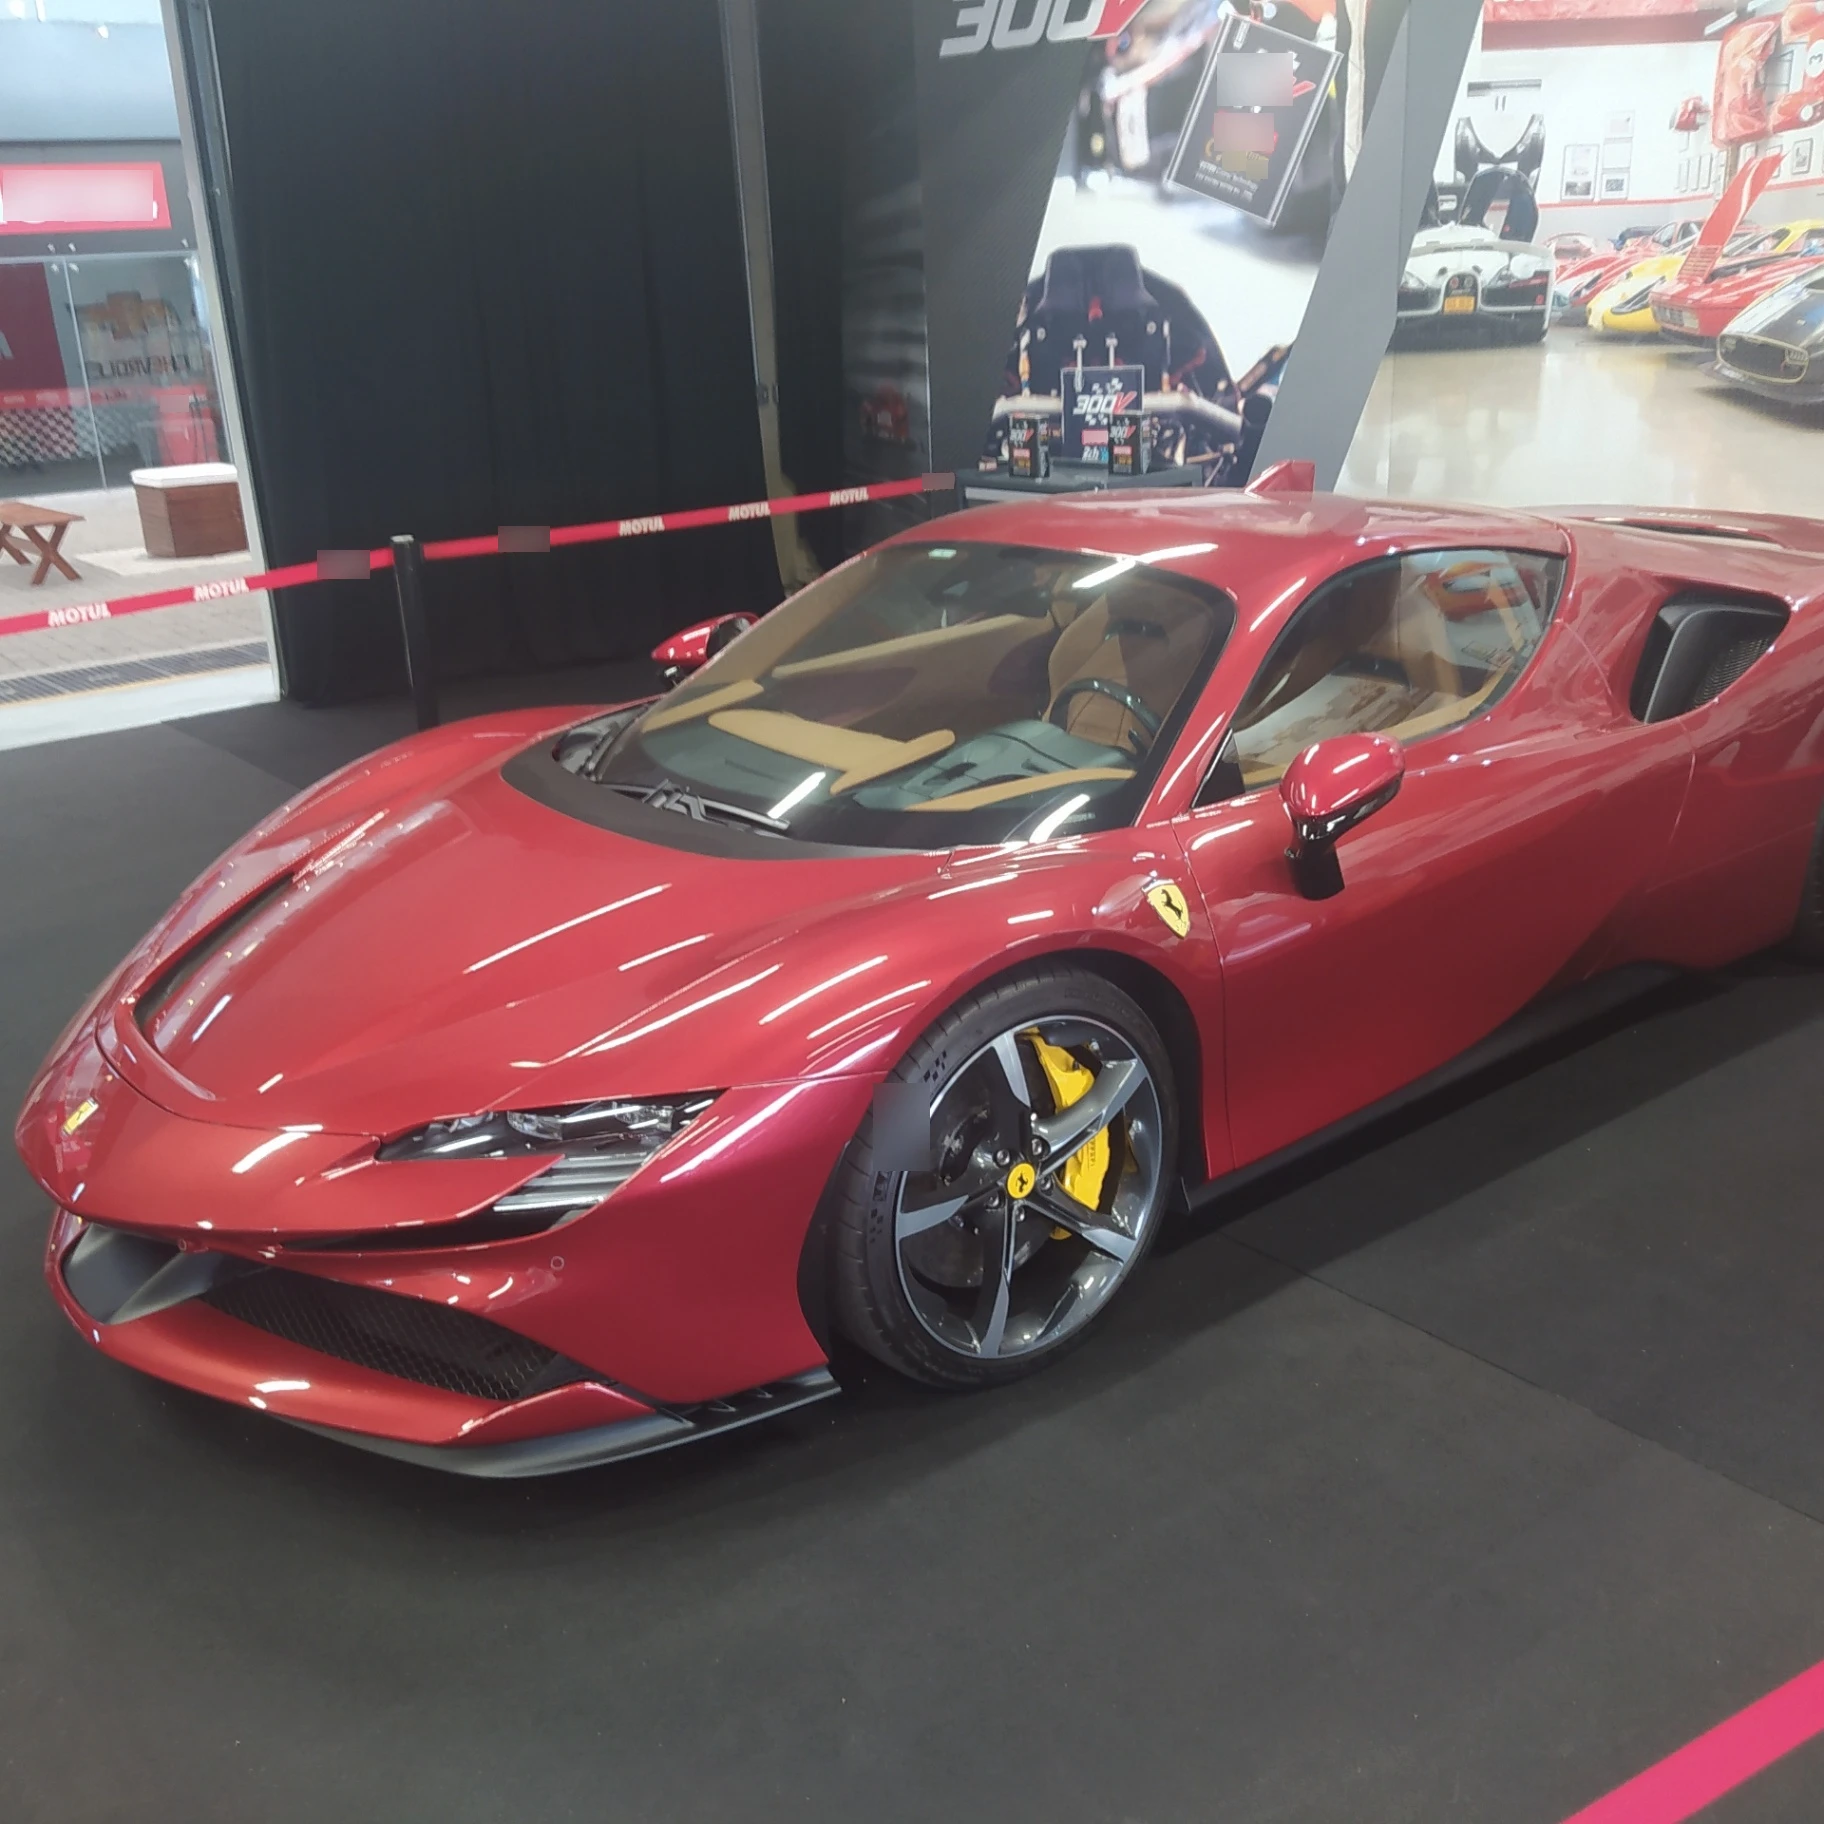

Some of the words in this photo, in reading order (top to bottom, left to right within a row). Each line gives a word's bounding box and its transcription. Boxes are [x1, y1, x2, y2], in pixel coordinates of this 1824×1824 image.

[939, 0, 1148, 58] 300V
[1073, 391, 1137, 415] 300V
[830, 487, 868, 506] MOTUL
[728, 502, 770, 521] MOTUL
[619, 516, 664, 536] MOTUL
[194, 577, 249, 601] MOTUL
[48, 602, 111, 627] MOTUL
